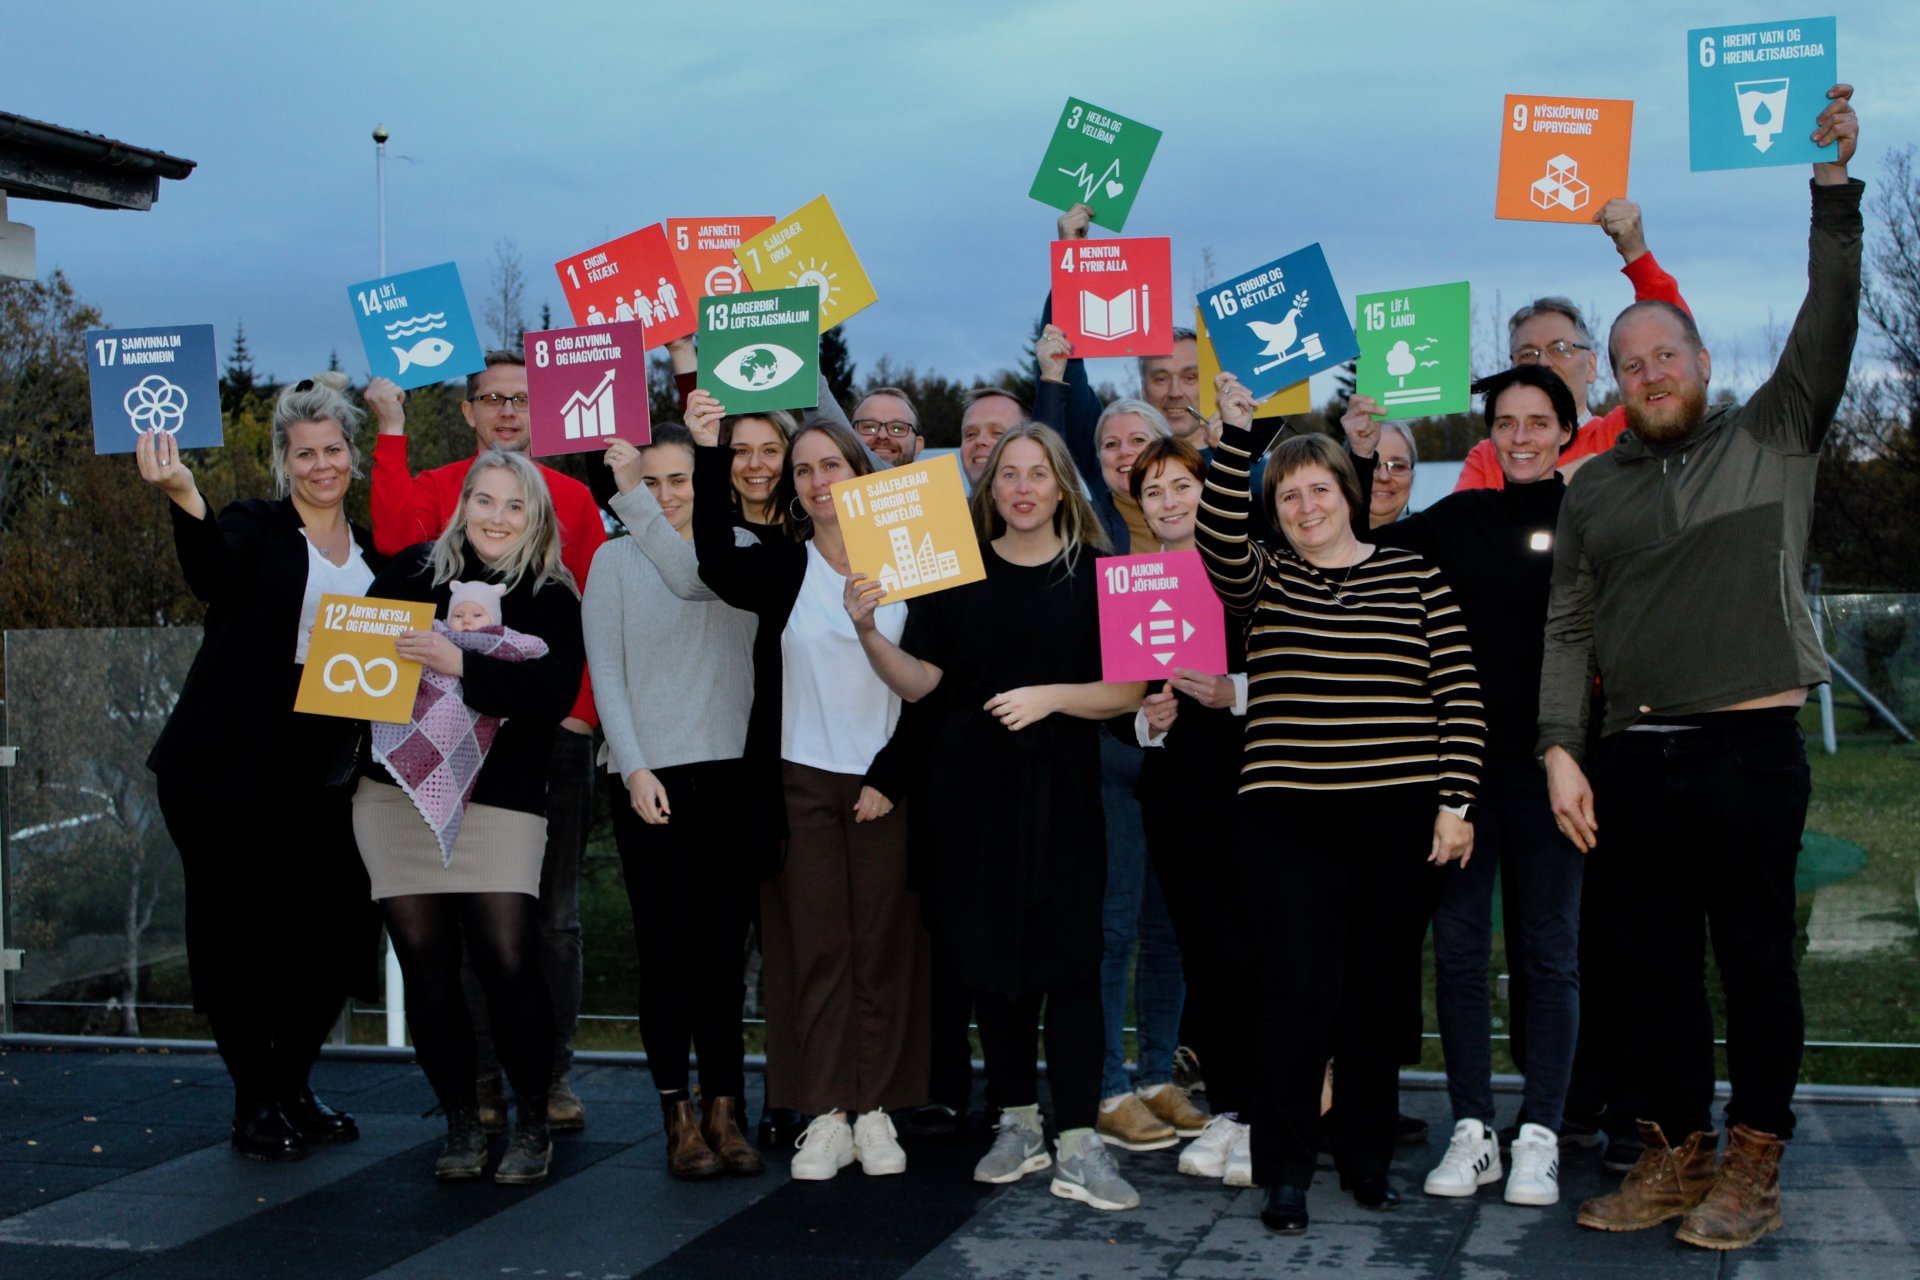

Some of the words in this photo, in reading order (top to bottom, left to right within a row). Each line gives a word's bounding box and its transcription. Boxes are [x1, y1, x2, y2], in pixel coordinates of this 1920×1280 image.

[1723, 33, 1756, 48] HREINT
[1760, 30, 1784, 45] VATN
[1787, 28, 1800, 42] OG
[1700, 37, 1715, 67] 6
[1723, 43, 1824, 65] HREINLÆTISAÐSTAÐA
[1066, 106, 1083, 130] 3
[1086, 111, 1111, 129] HEILSA
[1110, 120, 1122, 132] OG
[1513, 104, 1528, 131] 9
[1534, 104, 1584, 119] NÝSKÖPUN
[1585, 108, 1599, 120] OG
[1082, 123, 1115, 145] VELLÍÐAN
[1533, 120, 1592, 135] UPPBYGGING
[676, 226, 690, 250] 5
[698, 224, 740, 236] JAFNRÉTTI
[763, 222, 802, 252] SJÁLFBÆR
[583, 252, 608, 270] ENGIN
[746, 248, 762, 274] 7
[770, 245, 792, 264] ORKA
[1060, 248, 1075, 273] 4
[1080, 246, 1120, 258] MENNTUN
[587, 262, 619, 283] FÁTÆKT
[1080, 260, 1105, 272] FYRIR
[1106, 260, 1128, 272] ALLA
[567, 265, 580, 289] 1
[1235, 273, 1269, 296] FRIÐUR
[1268, 267, 1283, 282] OG
[379, 284, 391, 298] LÍF
[1240, 281, 1286, 310] RÉTTLÆTI
[358, 289, 382, 316] 14
[383, 296, 408, 311] VATNI
[731, 299, 775, 315] AÐGERÐIR
[1209, 289, 1238, 320] 16
[1391, 298, 1403, 313] LÍF
[706, 304, 729, 331] 13
[730, 310, 809, 329] LOFTSLAGSMÁLUM
[1364, 302, 1385, 331] 15
[1391, 313, 1415, 328] LANDI
[95, 338, 118, 367] 17
[121, 336, 170, 350] SAMVINNA
[171, 335, 181, 347] UM
[555, 336, 574, 351] GÓÐ
[574, 333, 612, 349] ATVINNA
[122, 350, 174, 365] MARKMIÐIN
[535, 340, 549, 368] 8
[556, 353, 569, 366] OG
[569, 347, 621, 364] HAGVÖXTUR
[866, 471, 928, 497] SJÁLFBÆRAR
[842, 488, 865, 519] 11
[870, 493, 906, 512] BORGIR
[905, 489, 920, 502] OG
[874, 504, 923, 527] SAMFÉLÖG
[1104, 565, 1129, 595] 10
[1131, 562, 1164, 577] AUKINN
[1132, 576, 1179, 592] JÖFNUÐUR
[324, 603, 347, 630] 12
[349, 604, 378, 619] ÁBYRG
[379, 608, 410, 623] NEYSLA
[346, 619, 359, 632] OG
